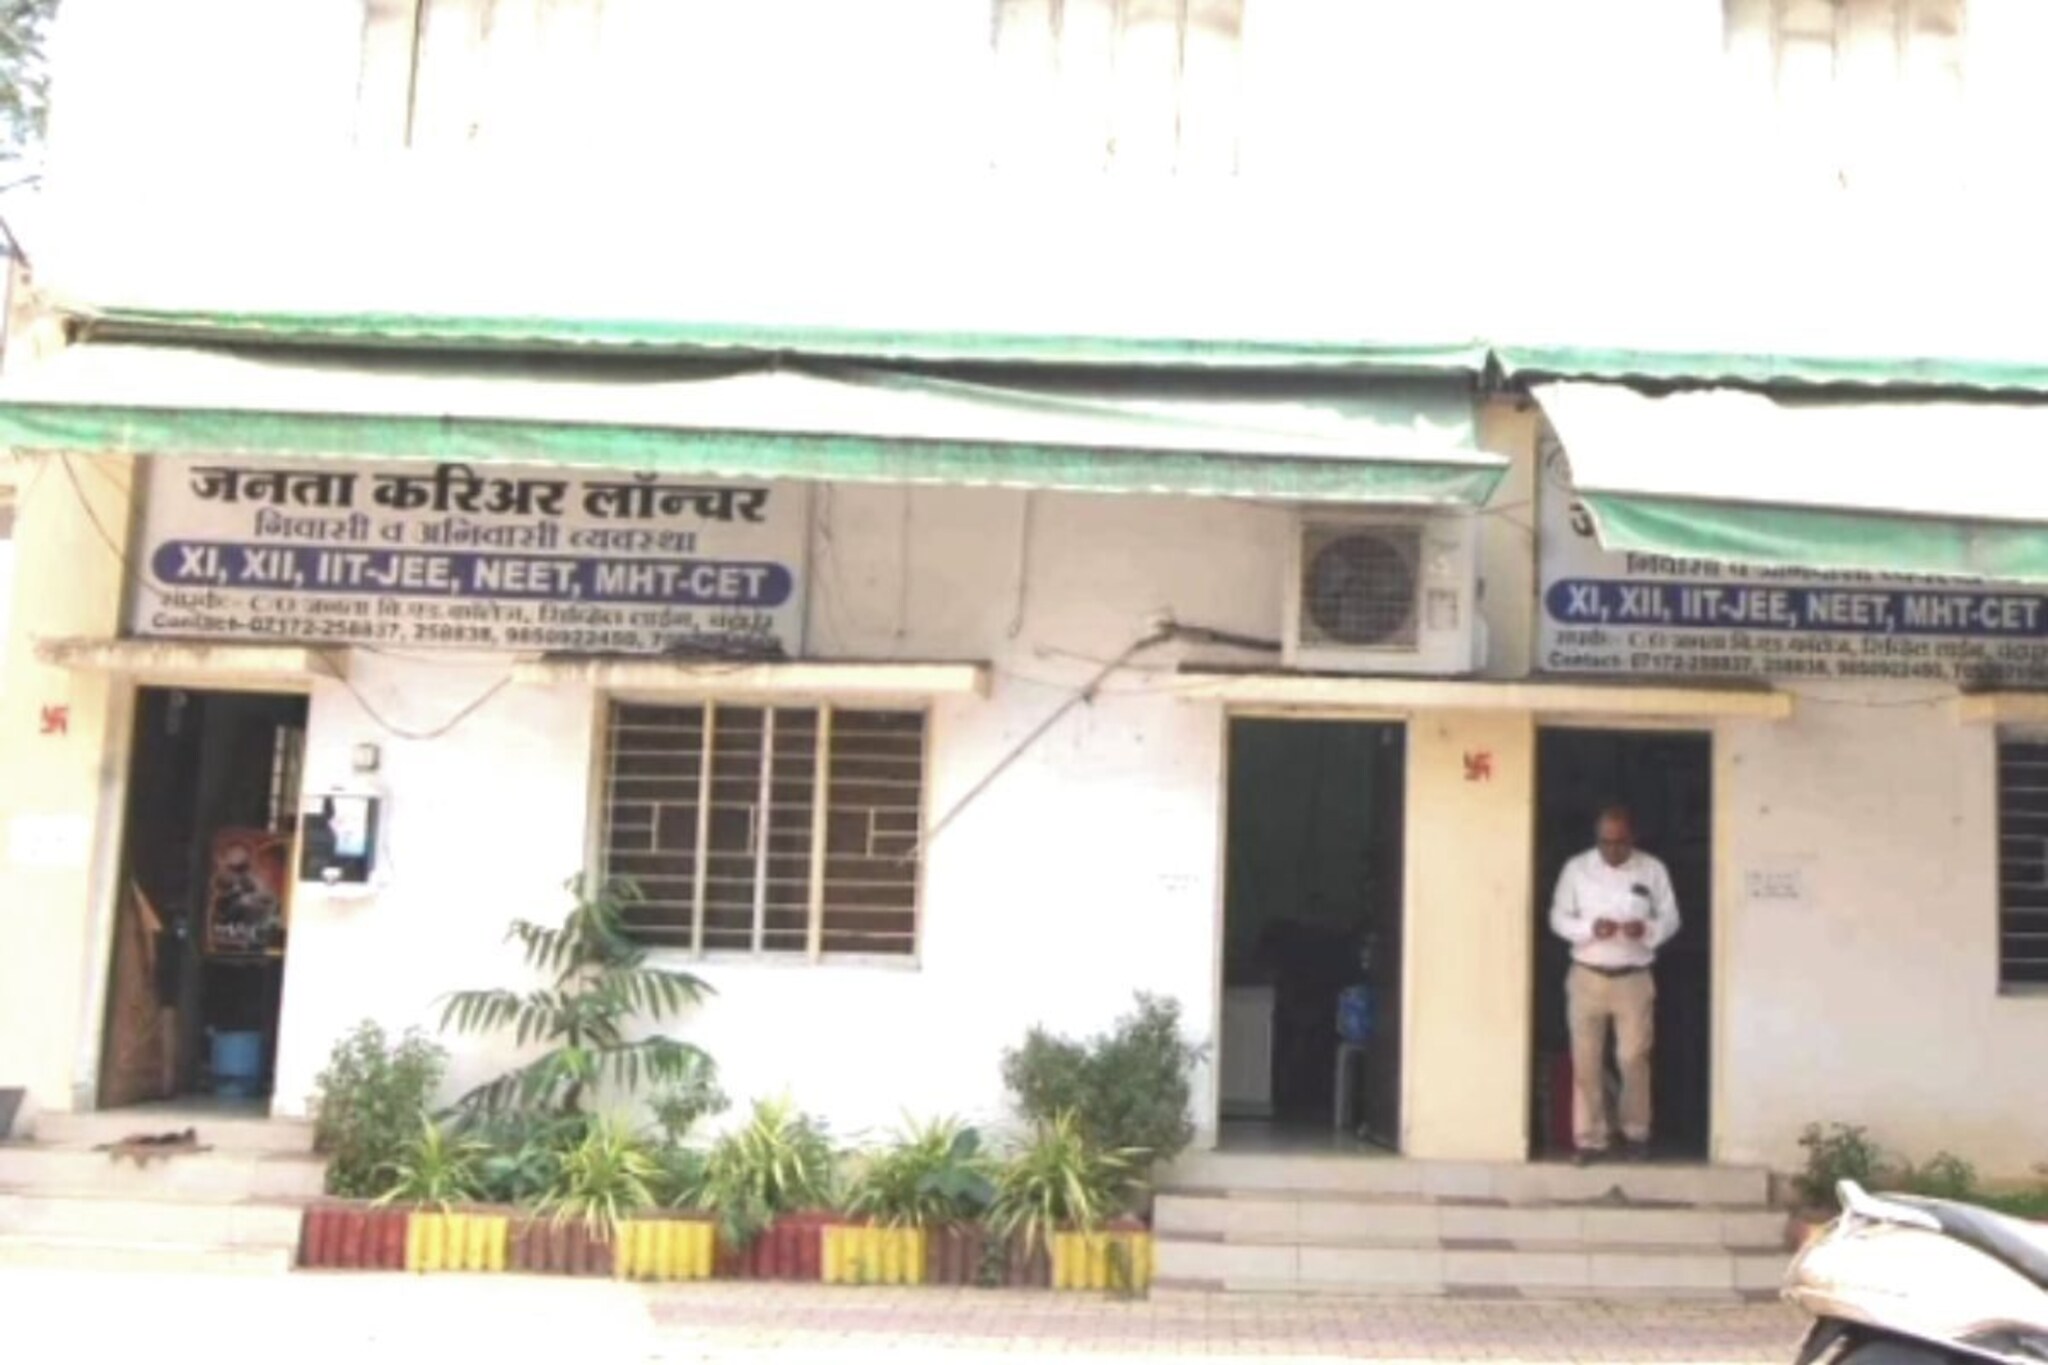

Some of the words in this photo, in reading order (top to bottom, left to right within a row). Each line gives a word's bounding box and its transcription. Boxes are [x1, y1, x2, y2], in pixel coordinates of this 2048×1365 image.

[190, 466, 358, 507] जनता
[372, 463, 568, 516] करिअर
[583, 471, 770, 522] लॉन्चर
[255, 508, 370, 541] निवासी
[381, 523, 404, 544] व
[420, 518, 559, 549] अनिवासी
[569, 527, 697, 553] व्यवस्था
[178, 545, 228, 585] XI,
[240, 548, 304, 590] XII,
[317, 553, 460, 590] IIT-JEE,
[472, 558, 581, 599] NEET,
[596, 564, 769, 600] MHT-CET
[1567, 584, 1610, 622] XI,
[1618, 586, 1673, 624] XII,
[1681, 588, 1797, 628] IIT-JEE,
[1806, 593, 1896, 632] NEET,
[1902, 595, 2041, 630] MHT-CET
